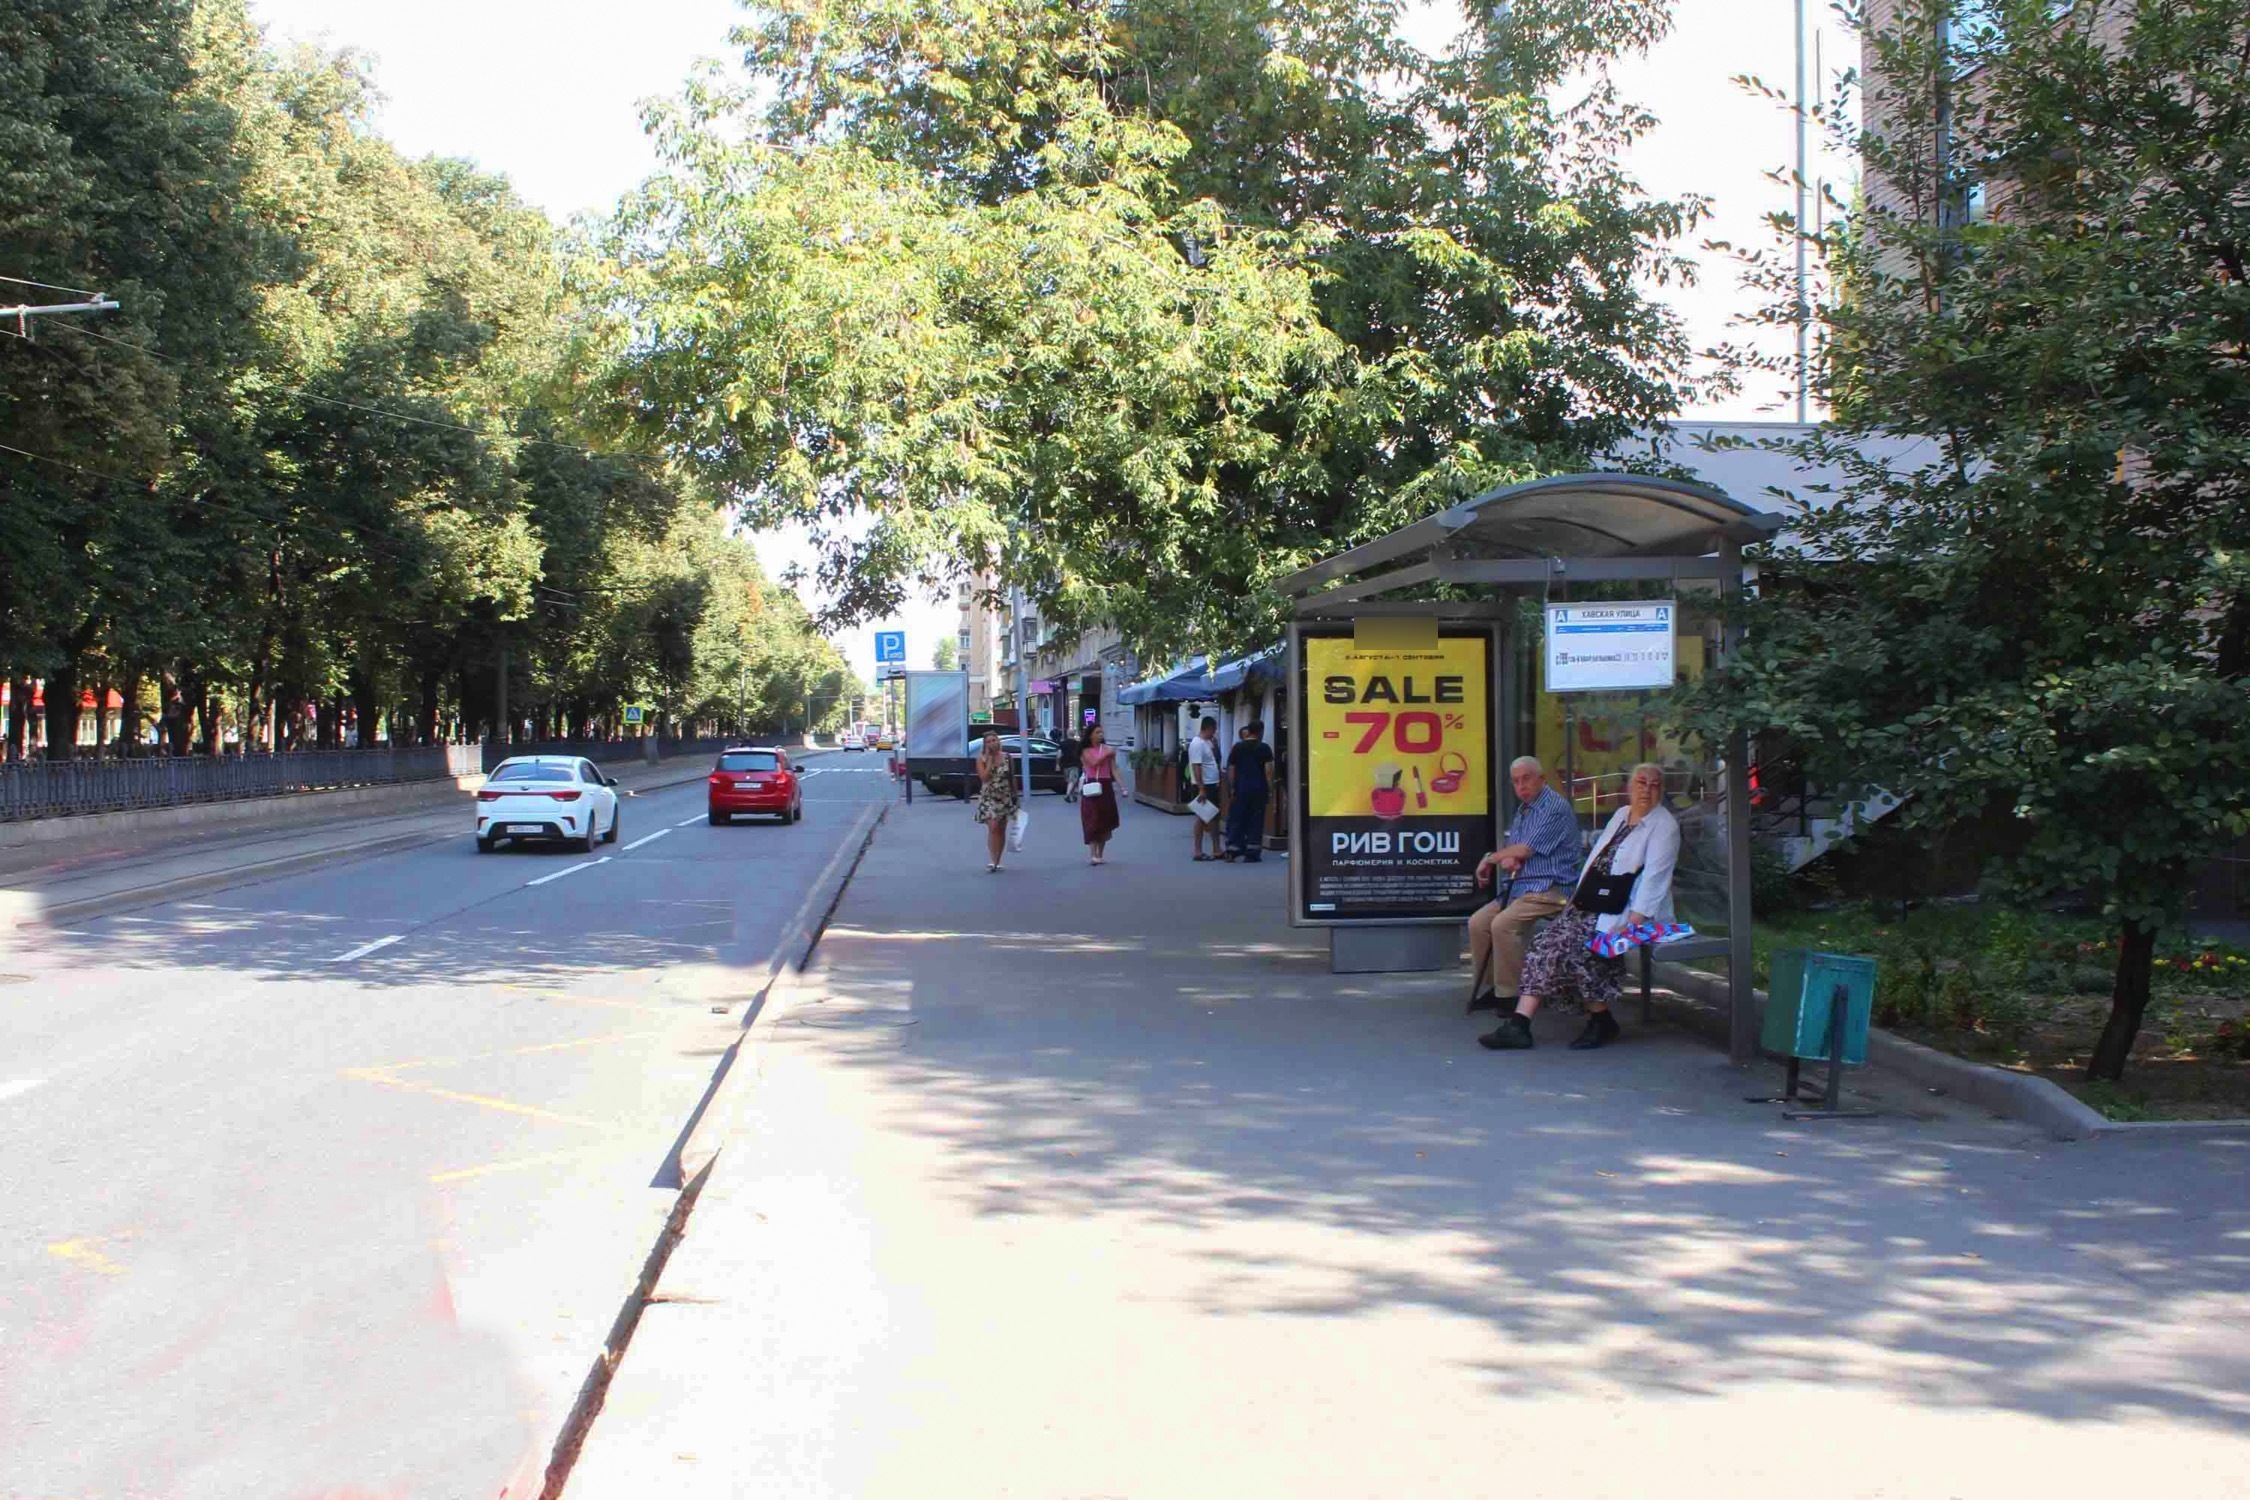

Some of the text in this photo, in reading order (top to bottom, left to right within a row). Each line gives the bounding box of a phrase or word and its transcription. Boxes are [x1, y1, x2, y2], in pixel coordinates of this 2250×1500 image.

[1581, 609, 1641, 619] ХАВСКАЯ УЛИЦА
[883, 635, 901, 660] P
[1323, 675, 1464, 704] SALE
[1323, 711, 1465, 754] -70%
[1332, 831, 1460, 854] РИВ ГОШ
